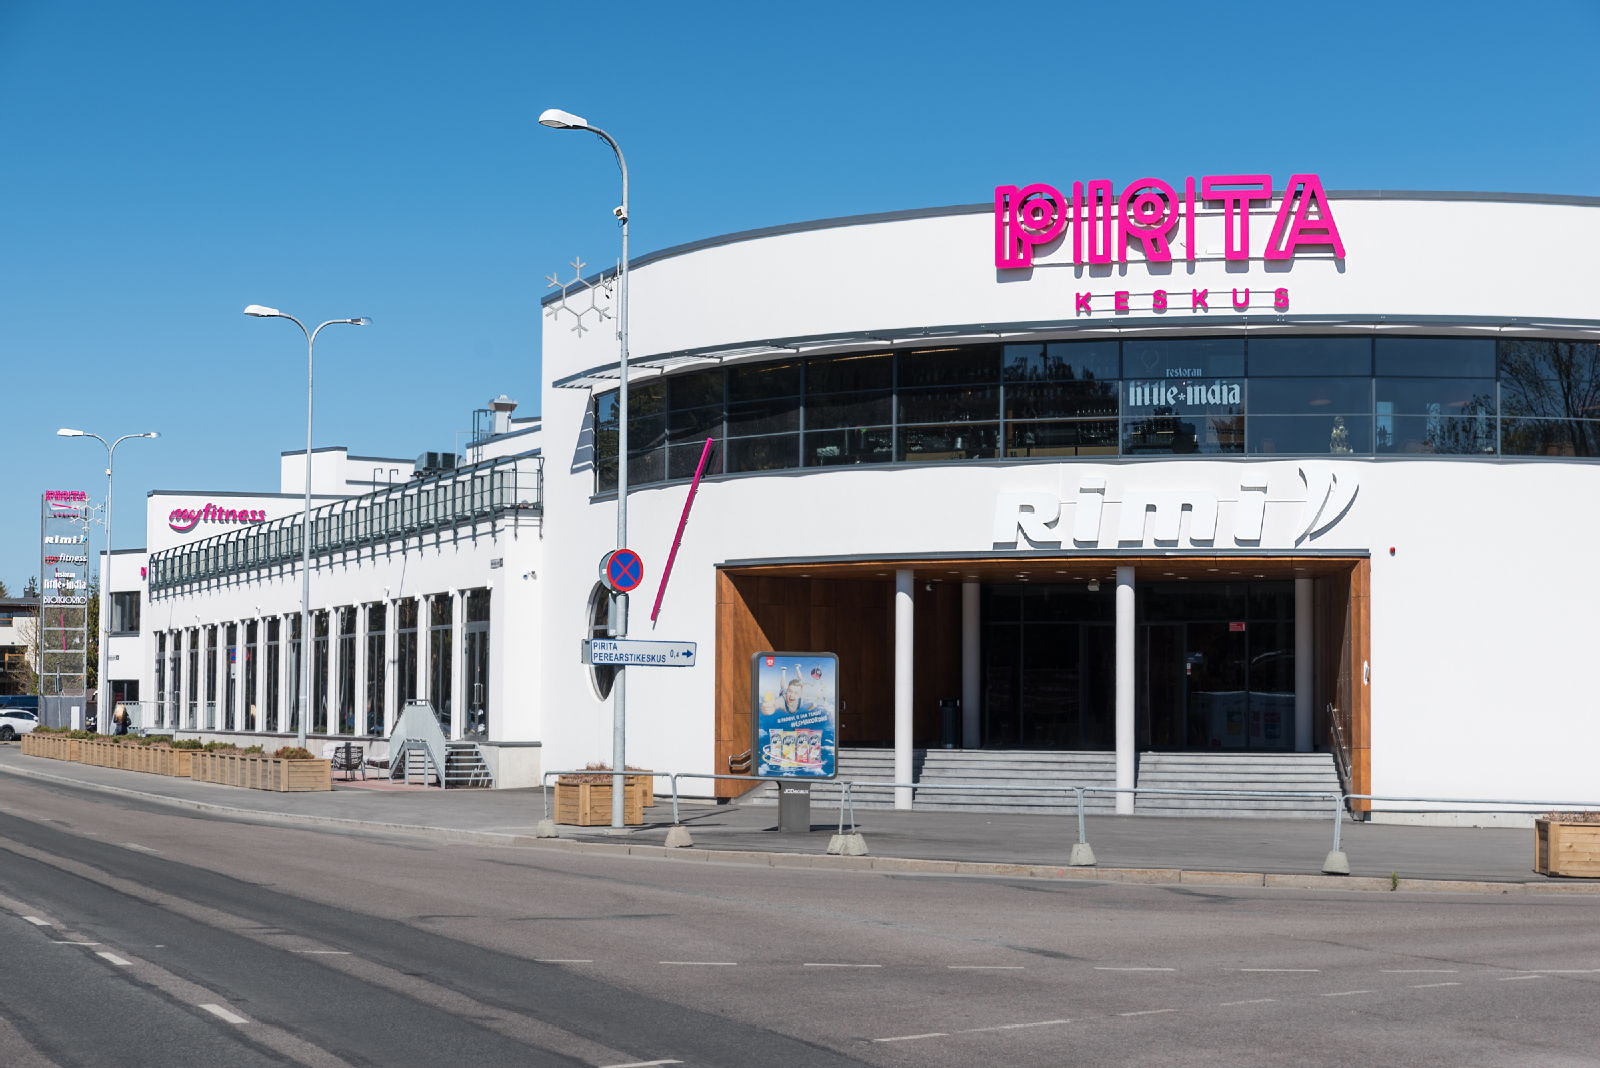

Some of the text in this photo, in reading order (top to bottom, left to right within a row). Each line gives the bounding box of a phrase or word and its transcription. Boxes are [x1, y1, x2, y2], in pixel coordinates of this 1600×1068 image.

[995, 174, 1346, 269] PIRITA
[1076, 288, 1290, 311] KESKUS
[1166, 367, 1202, 377] restoran
[169, 502, 266, 532] myfitness
[993, 476, 1267, 548] Rimi
[593, 642, 618, 651] PIRITA
[669, 649, 680, 659] 0,4
[593, 652, 667, 663] PEREARSTIKESKUS
